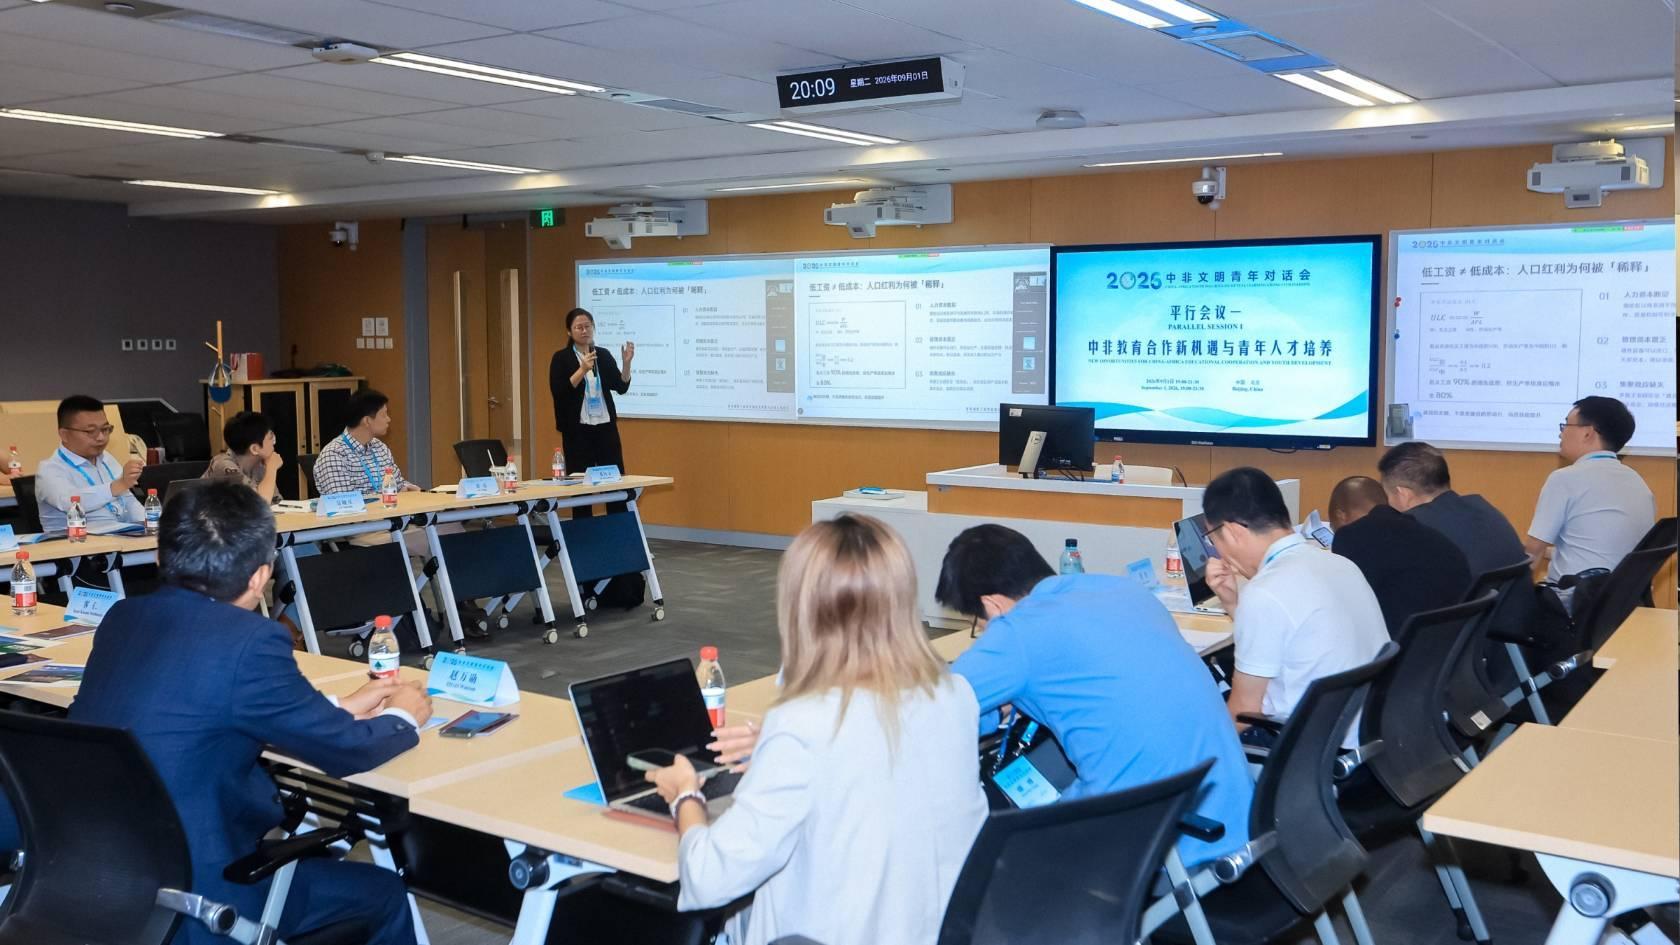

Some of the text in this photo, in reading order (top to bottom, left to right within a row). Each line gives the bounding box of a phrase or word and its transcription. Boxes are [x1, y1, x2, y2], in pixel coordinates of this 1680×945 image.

[790, 71, 929, 100] 20:09 星期二 2026年09月01日
[1166, 269, 1311, 284] 中非文明青年对话会
[1421, 266, 1456, 278] 低工资
[1170, 305, 1242, 321] 平行会议一
[1088, 339, 1332, 357] 中非教育合作新机遇与青年人才培养
